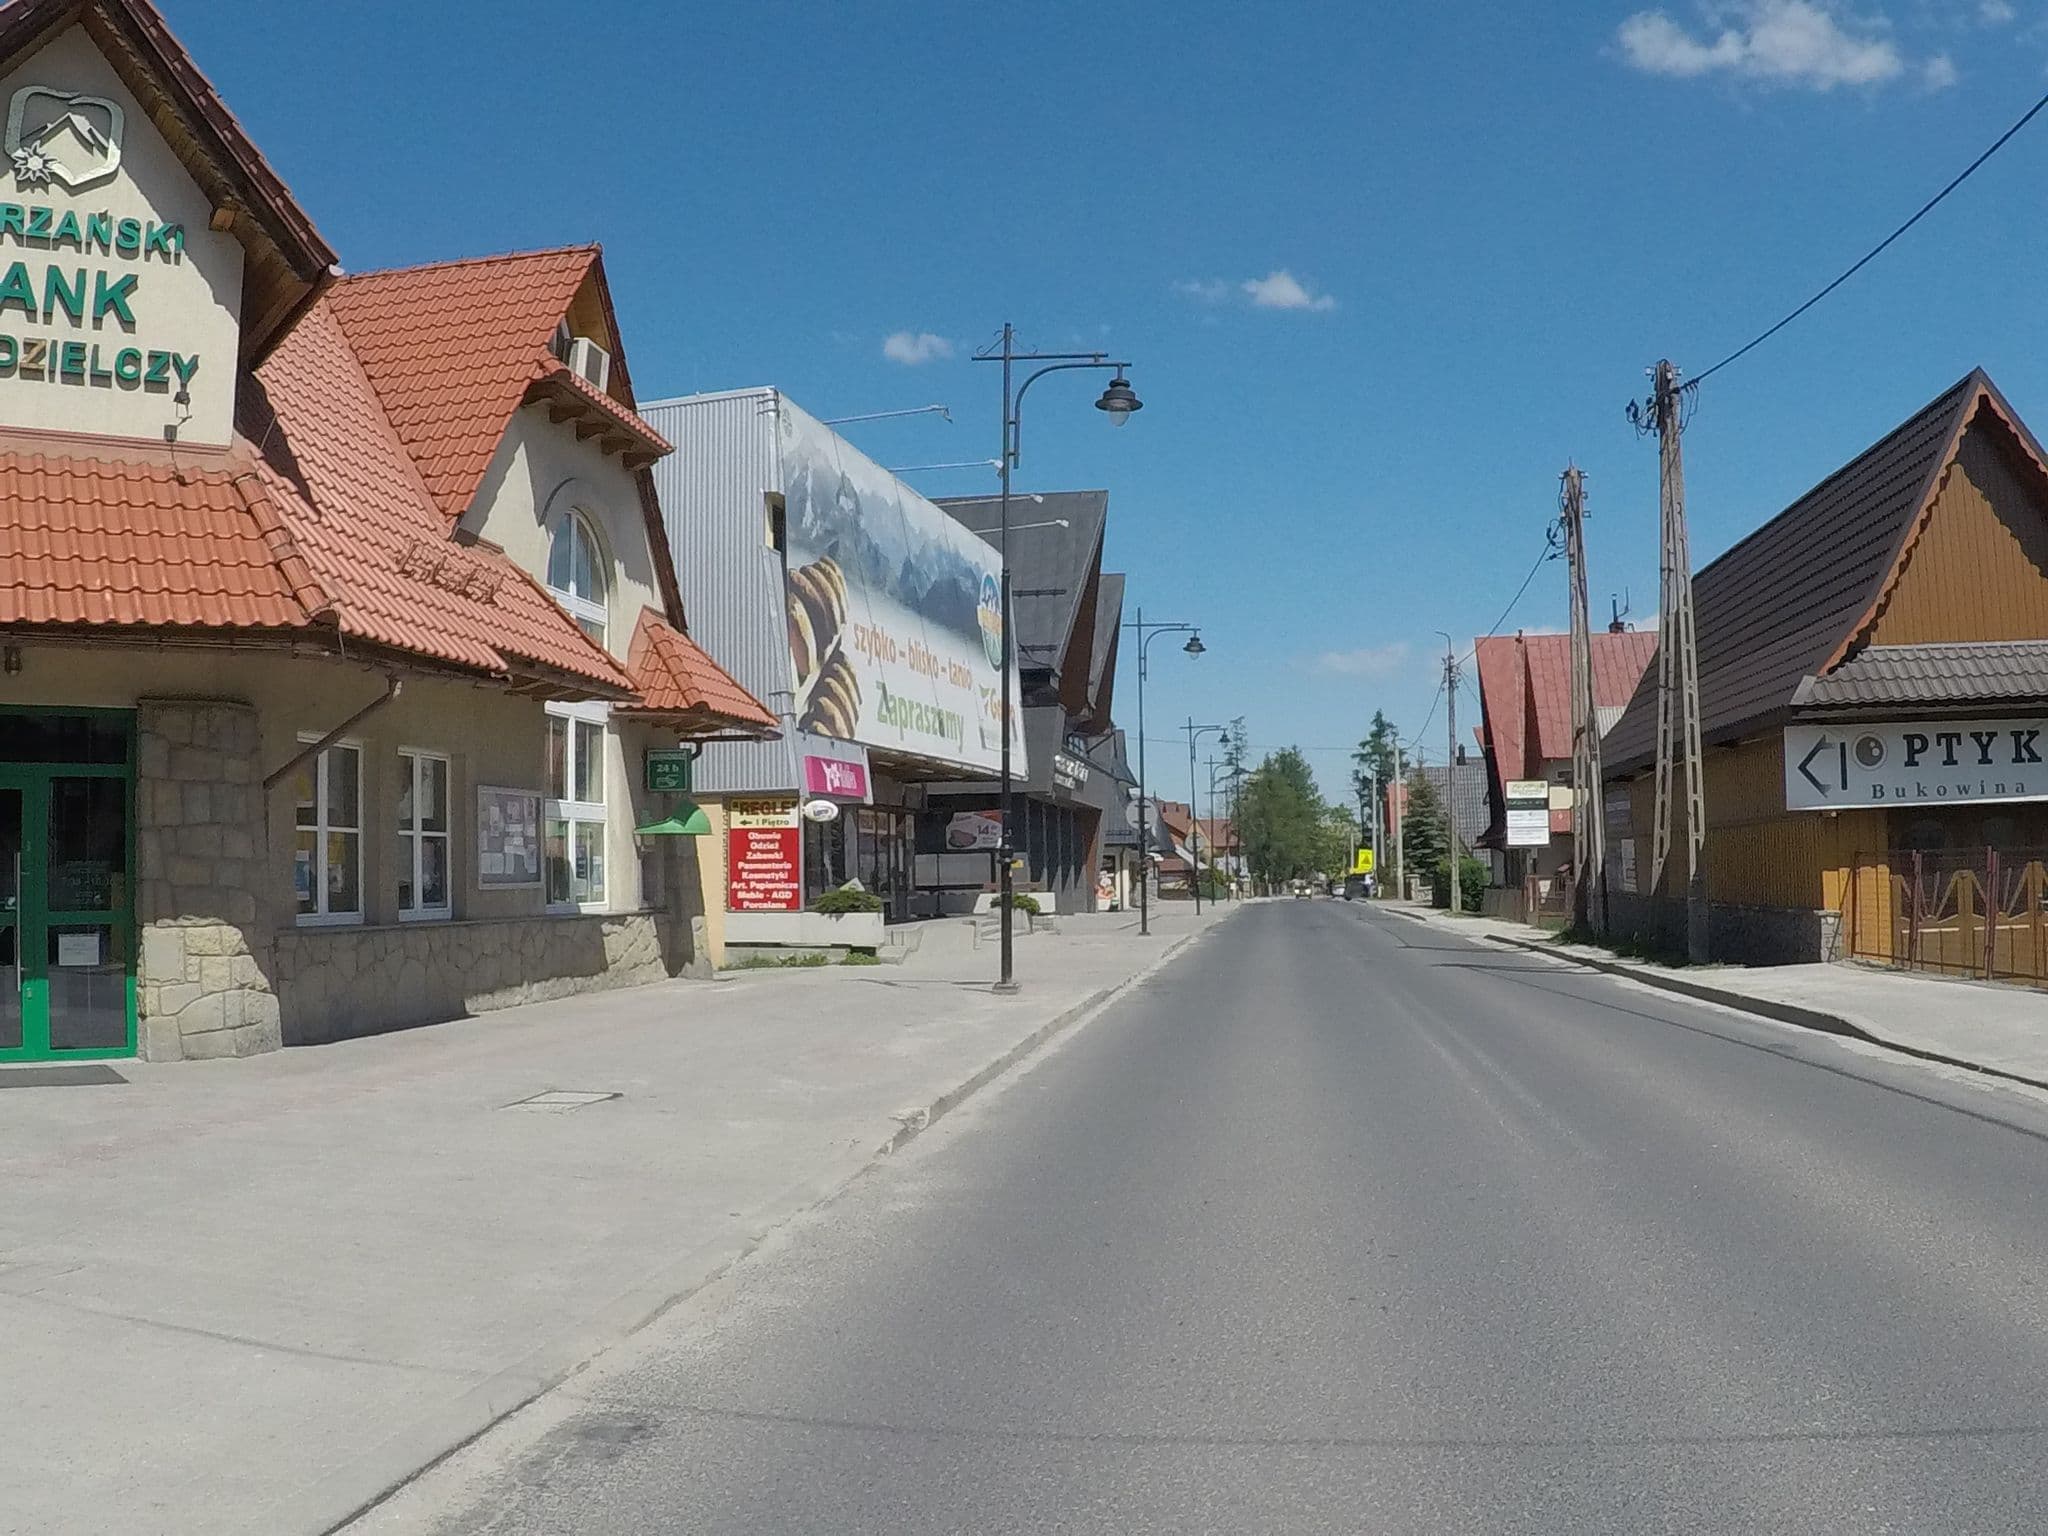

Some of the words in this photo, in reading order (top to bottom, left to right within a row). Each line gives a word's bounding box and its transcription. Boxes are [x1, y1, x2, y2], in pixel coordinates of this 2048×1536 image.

[854, 623, 897, 667] szybko
[908, 637, 939, 679] blisko
[948, 657, 973, 691] tanio
[876, 680, 965, 754] Zapraszamy
[1871, 780, 2026, 799] Bukowina
